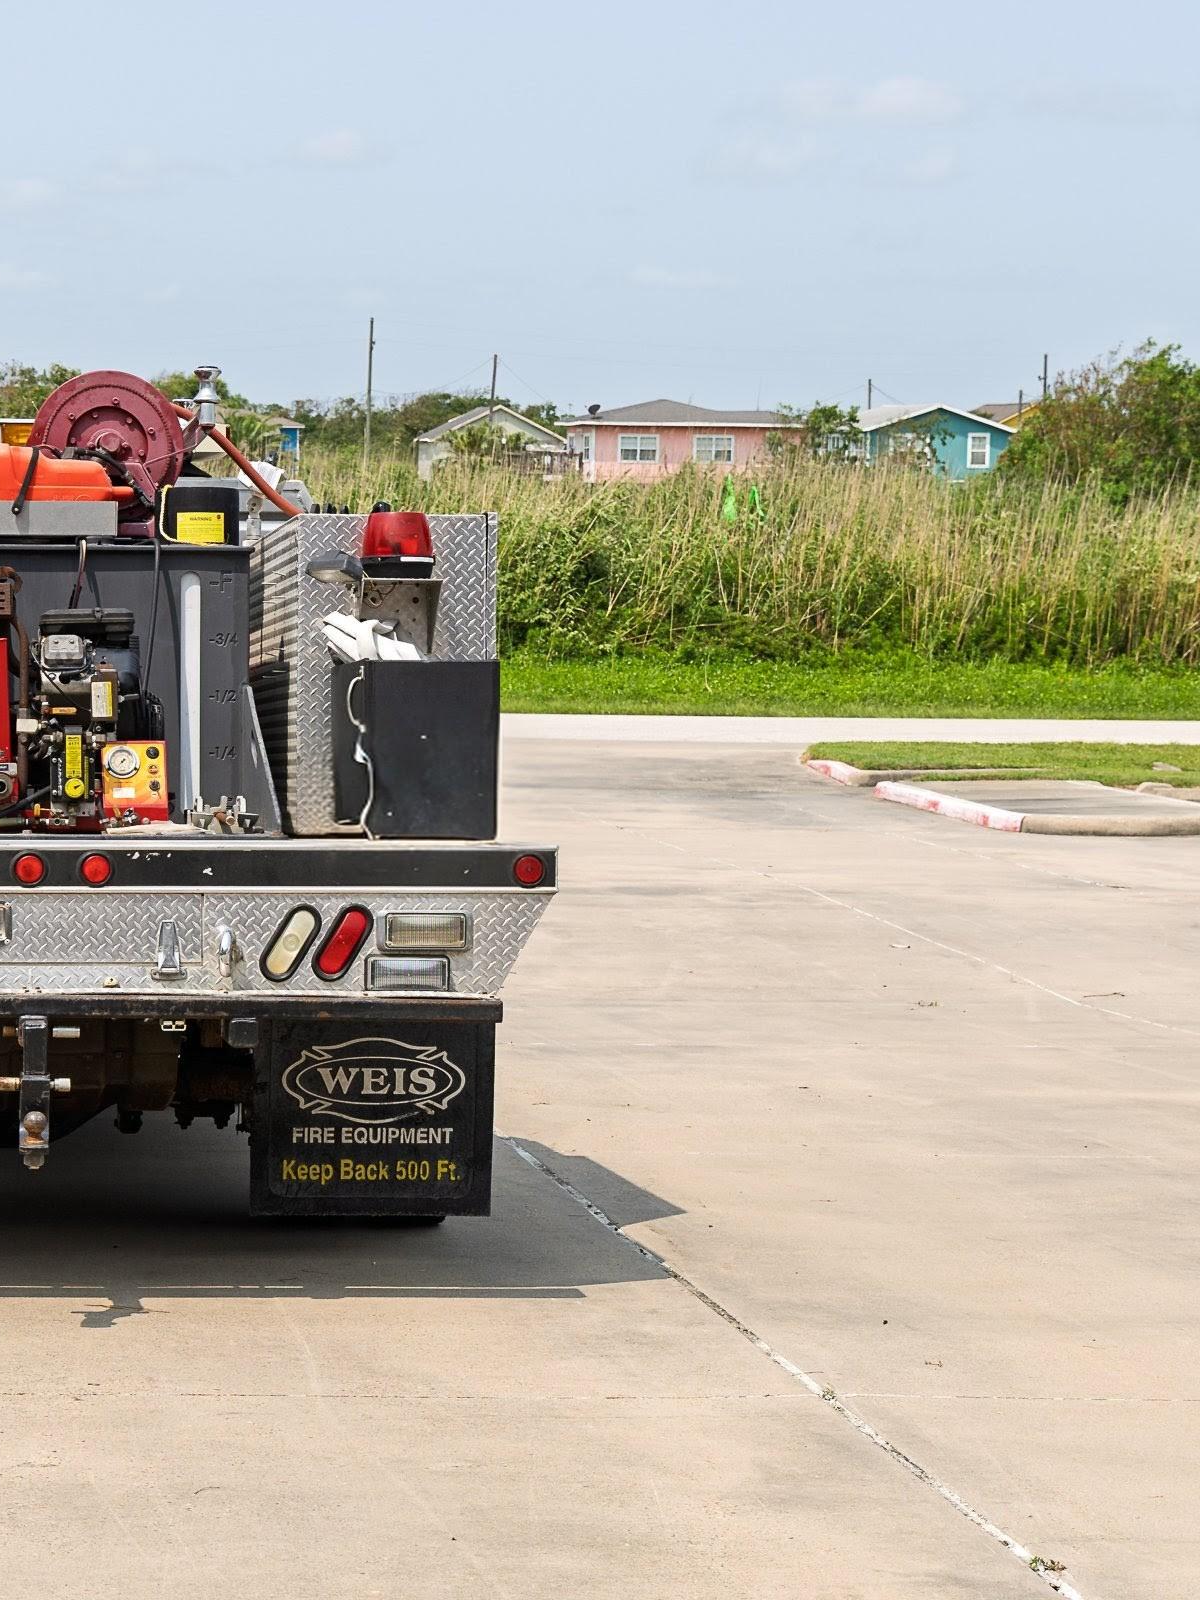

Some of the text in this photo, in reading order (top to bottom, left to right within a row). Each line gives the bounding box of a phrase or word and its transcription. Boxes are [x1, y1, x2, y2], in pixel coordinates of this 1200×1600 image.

[317, 1066, 436, 1095] WEIS
[292, 1127, 454, 1144] FIRE EQUIPMENT
[282, 1158, 461, 1185] Keep Back 500 Ft.
